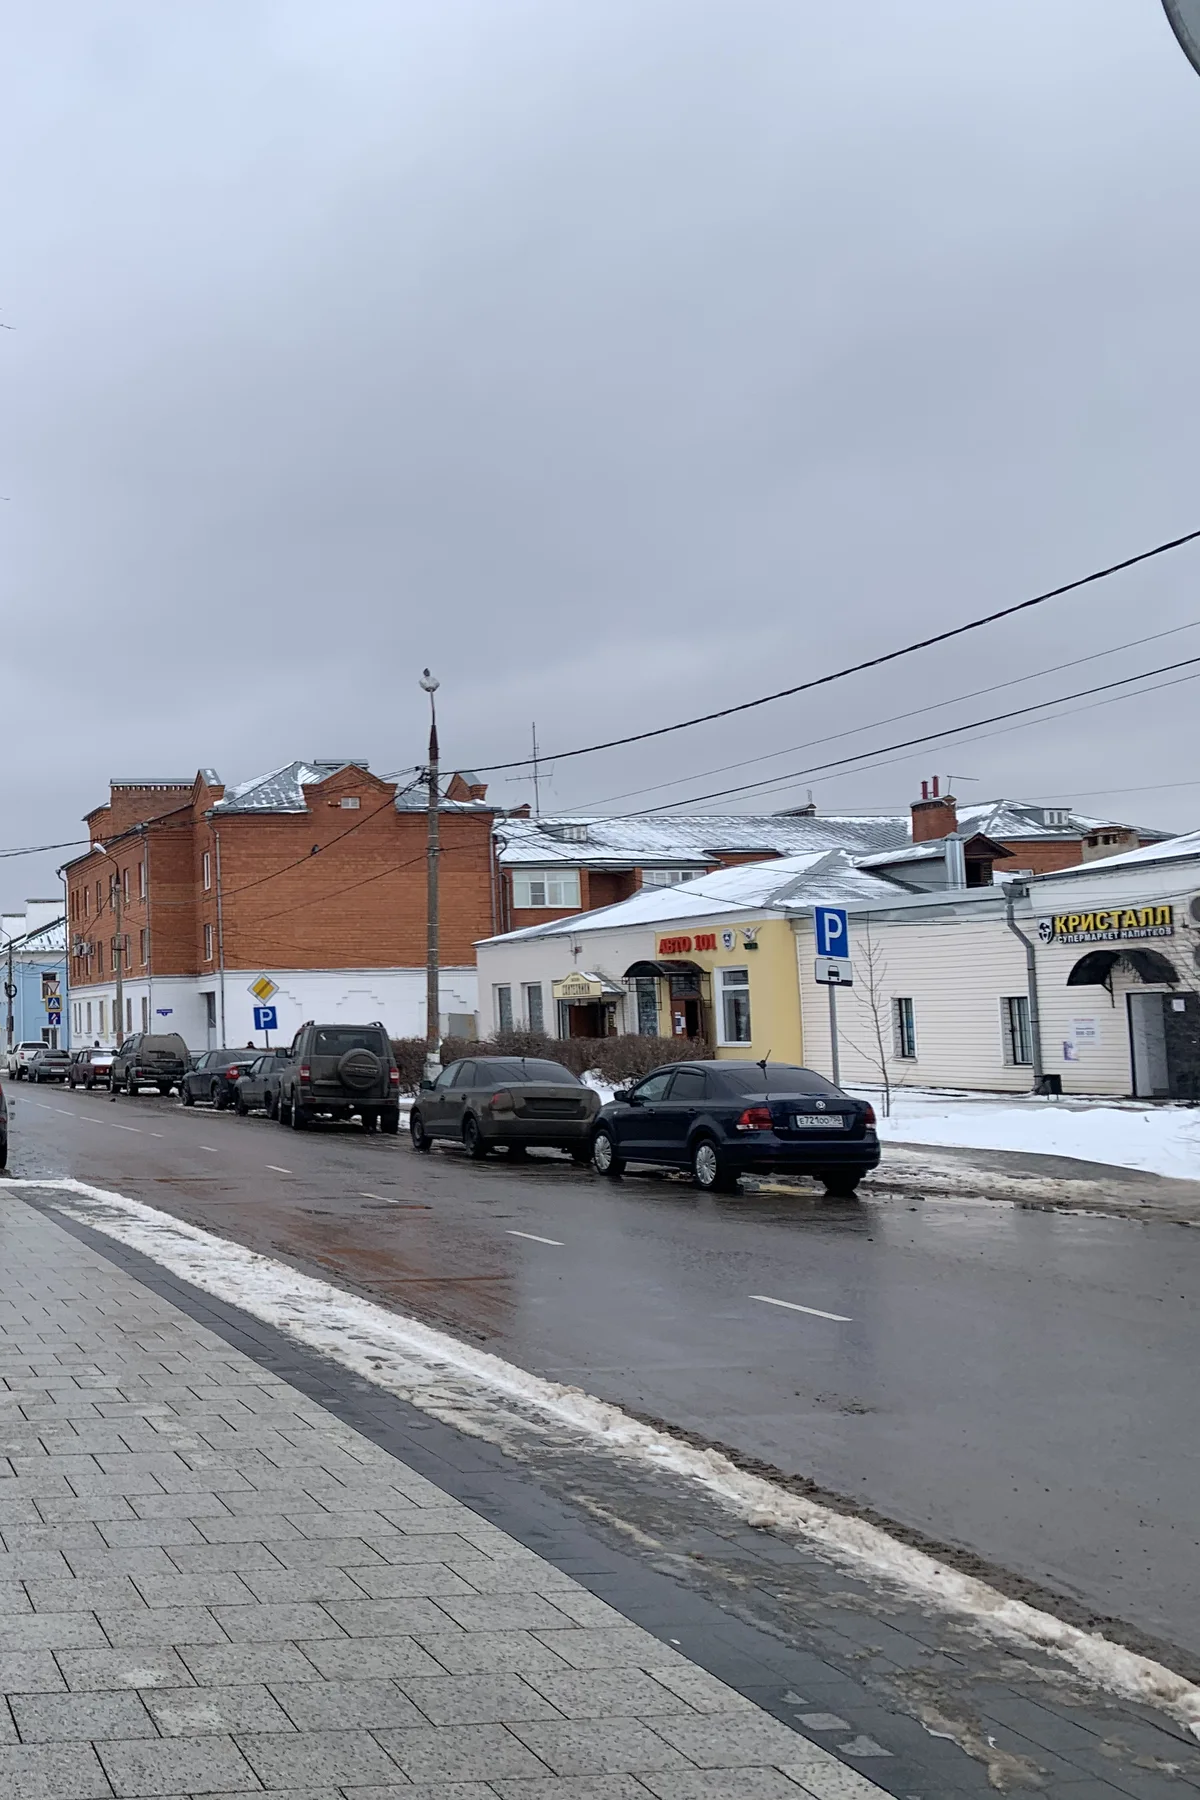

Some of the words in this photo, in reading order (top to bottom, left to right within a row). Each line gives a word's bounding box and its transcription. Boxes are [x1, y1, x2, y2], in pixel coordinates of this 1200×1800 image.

[1055, 905, 1173, 934] КРИСТАЛЛ
[824, 912, 843, 952] P
[1057, 931, 1120, 945] СУПЕРМАРКЕТ
[1122, 926, 1173, 940] НАПИТКОВ
[659, 936, 692, 955] АВТО
[694, 933, 718, 952] 101
[259, 1008, 274, 1028] P
